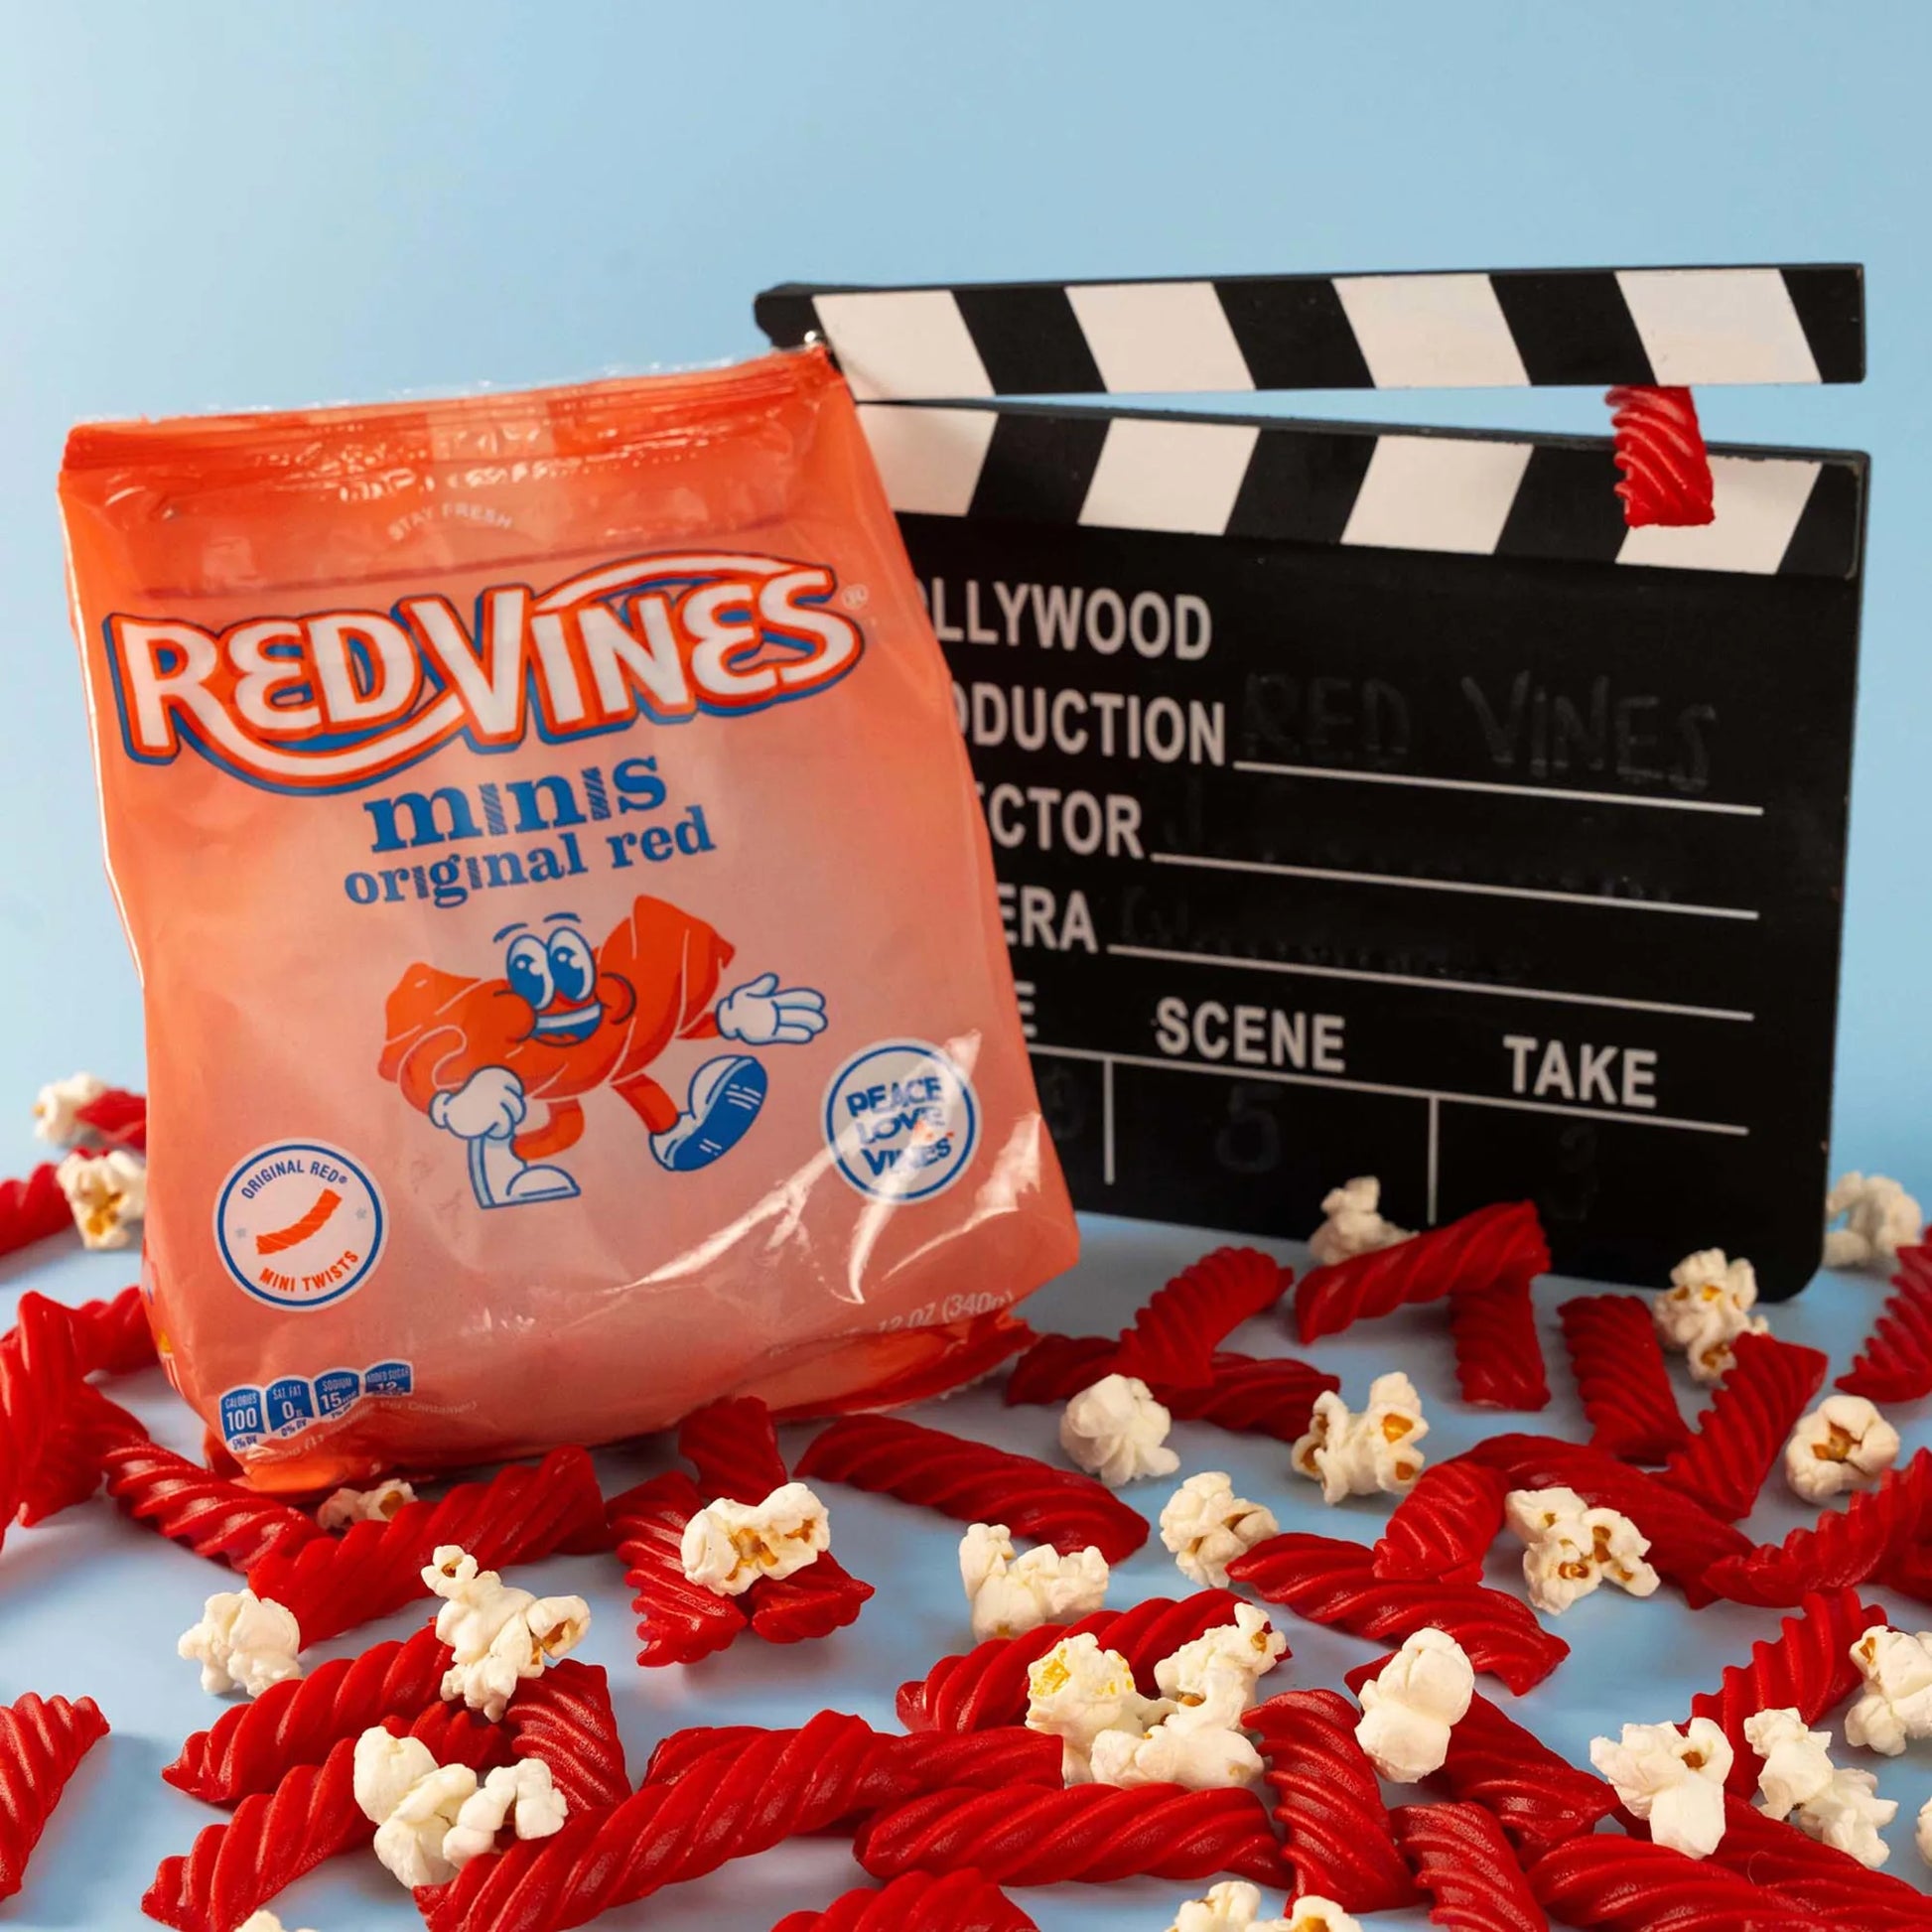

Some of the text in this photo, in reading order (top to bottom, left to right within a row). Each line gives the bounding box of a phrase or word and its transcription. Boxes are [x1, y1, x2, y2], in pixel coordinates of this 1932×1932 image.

[1460, 670, 1717, 793] VINES
[363, 756, 667, 854] minis
[976, 781, 1145, 860] CTOR
[344, 805, 717, 908] original red
[1155, 996, 1346, 1073] SCENE
[1502, 1034, 1660, 1110] TAKE
[846, 1076, 943, 1119] PEACE
[240, 1159, 305, 1200] ORIGINAL
[258, 1250, 359, 1293] MINI TWISTS
[224, 1392, 258, 1411] CALORIES
[225, 1406, 258, 1433] 100
